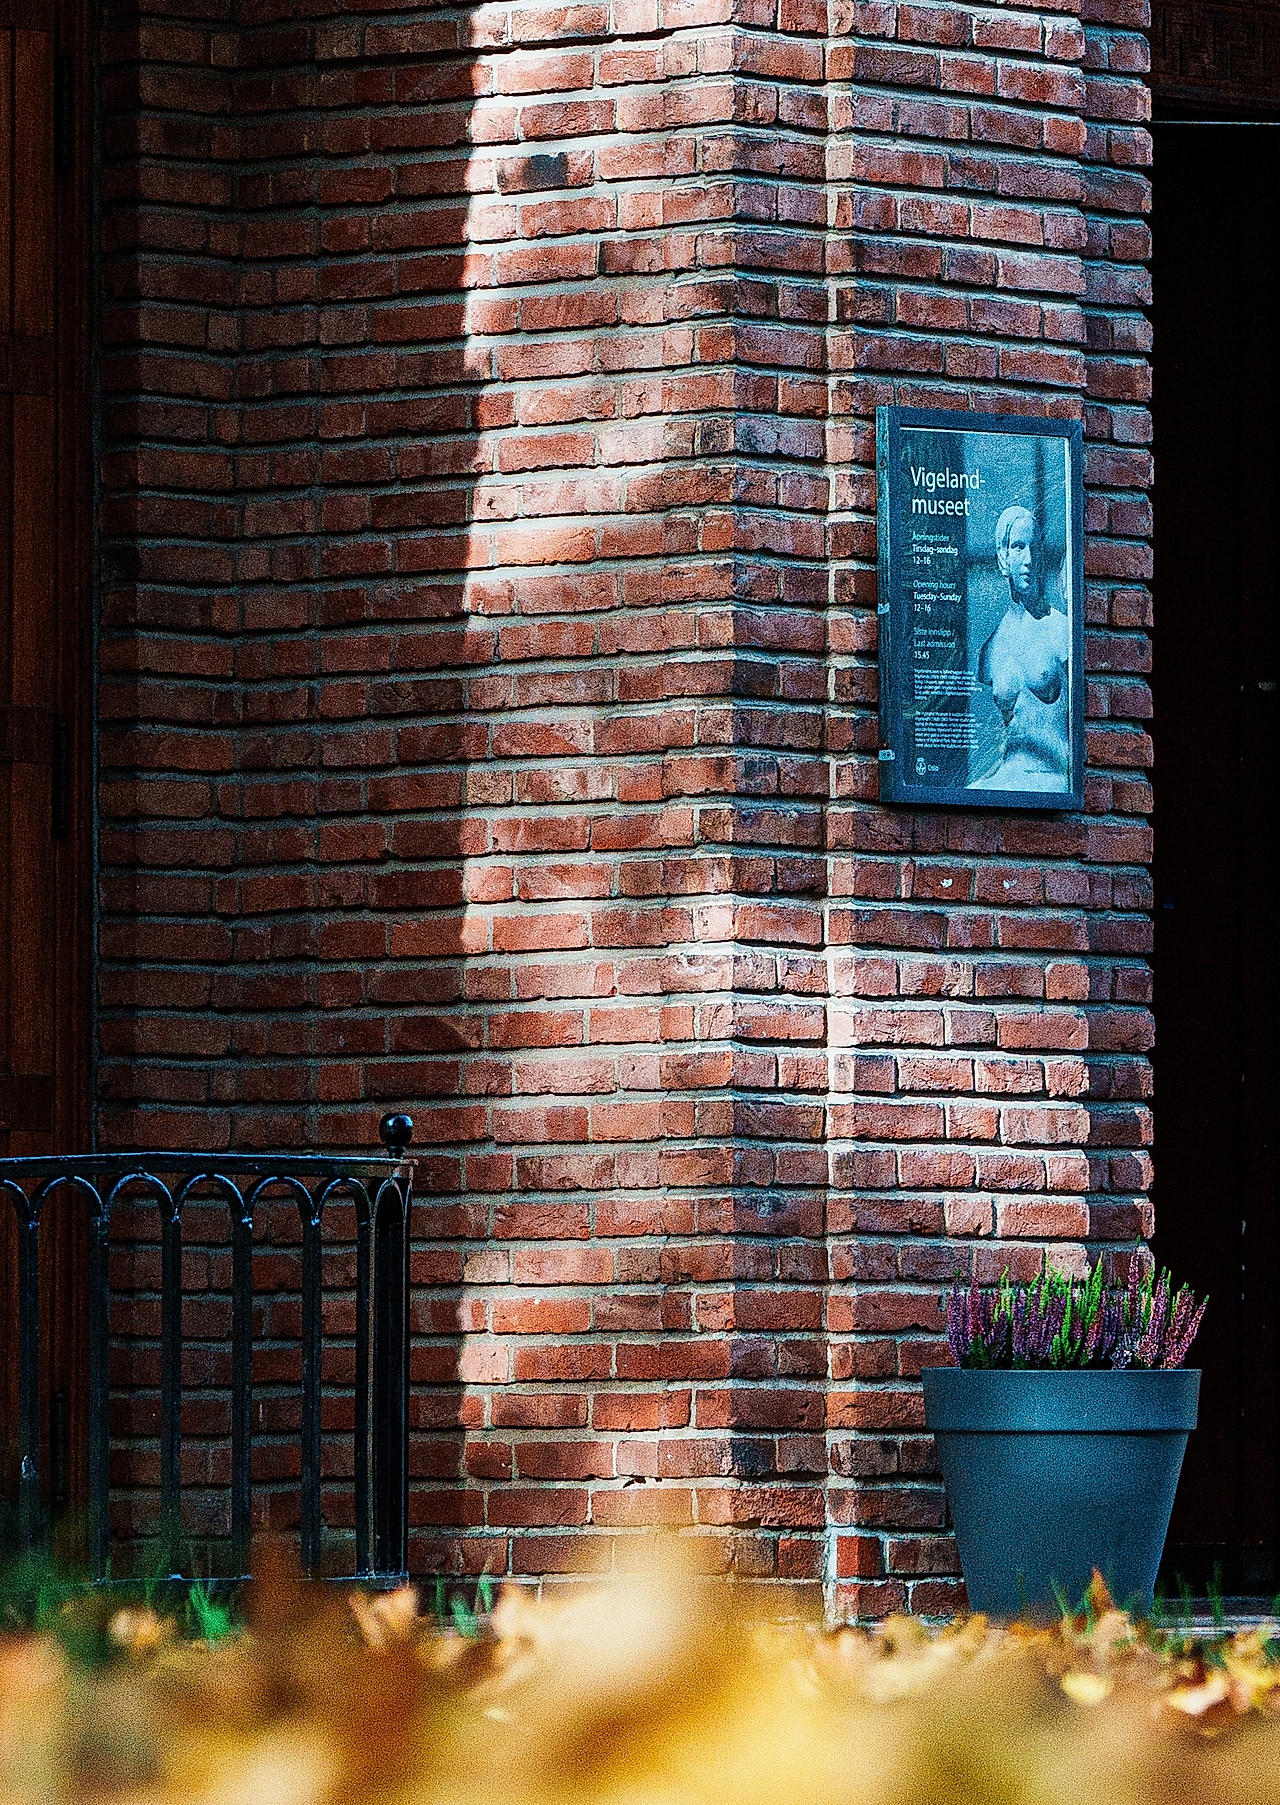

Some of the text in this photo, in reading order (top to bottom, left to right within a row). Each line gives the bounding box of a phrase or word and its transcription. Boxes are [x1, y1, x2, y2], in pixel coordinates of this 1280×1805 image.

[910, 466, 986, 493] Vigeland-
[912, 498, 971, 516] museet
[913, 580, 957, 591] Opening hours
